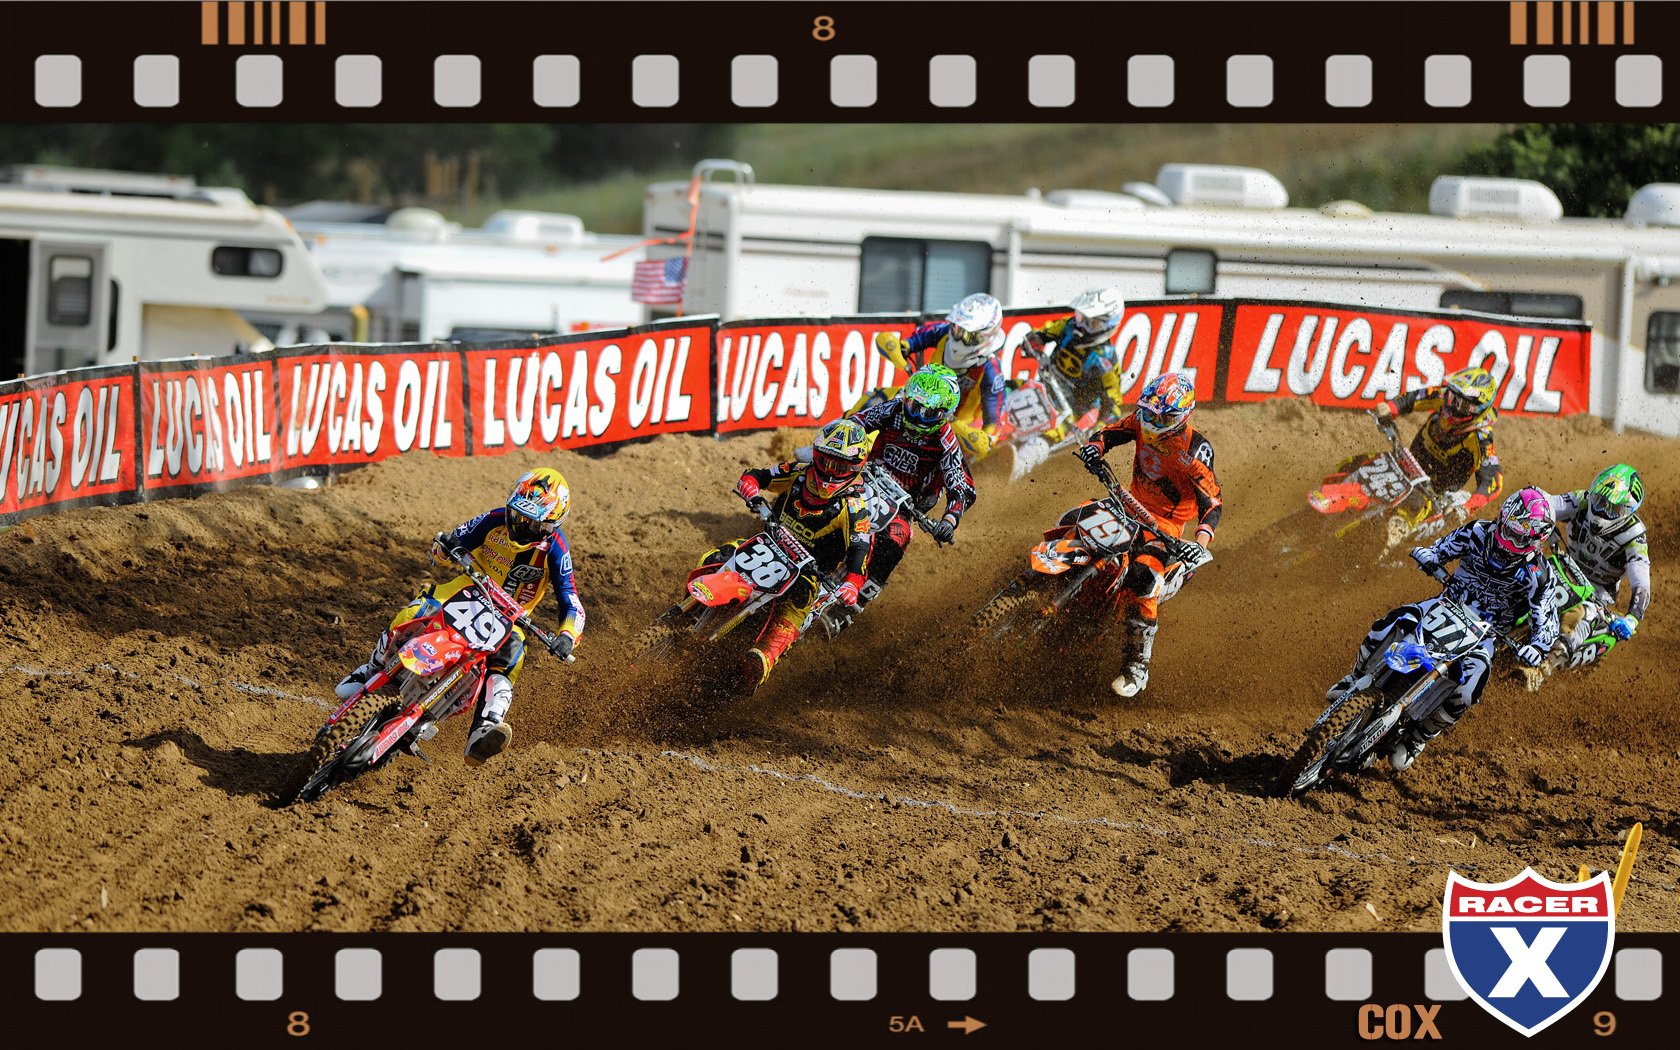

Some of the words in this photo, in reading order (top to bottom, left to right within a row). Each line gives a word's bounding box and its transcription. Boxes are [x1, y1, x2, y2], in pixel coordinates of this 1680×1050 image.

[716, 330, 831, 423] LUCAS
[1244, 313, 1456, 401] LUCAS
[148, 374, 225, 479] LUCAS
[223, 368, 271, 469] OIL
[287, 359, 387, 458] LUCAS
[393, 359, 453, 452] OIL
[483, 343, 623, 447] LUCAS
[627, 336, 692, 430] OIL
[70, 384, 122, 492] OIL
[779, 511, 815, 541] GEICO
[1079, 509, 1131, 548] 19
[735, 544, 790, 588] 38
[443, 600, 506, 648] 49
[1422, 605, 1479, 652] 577
[424, 691, 438, 706] PRO
[437, 670, 460, 694] CIRCUIT
